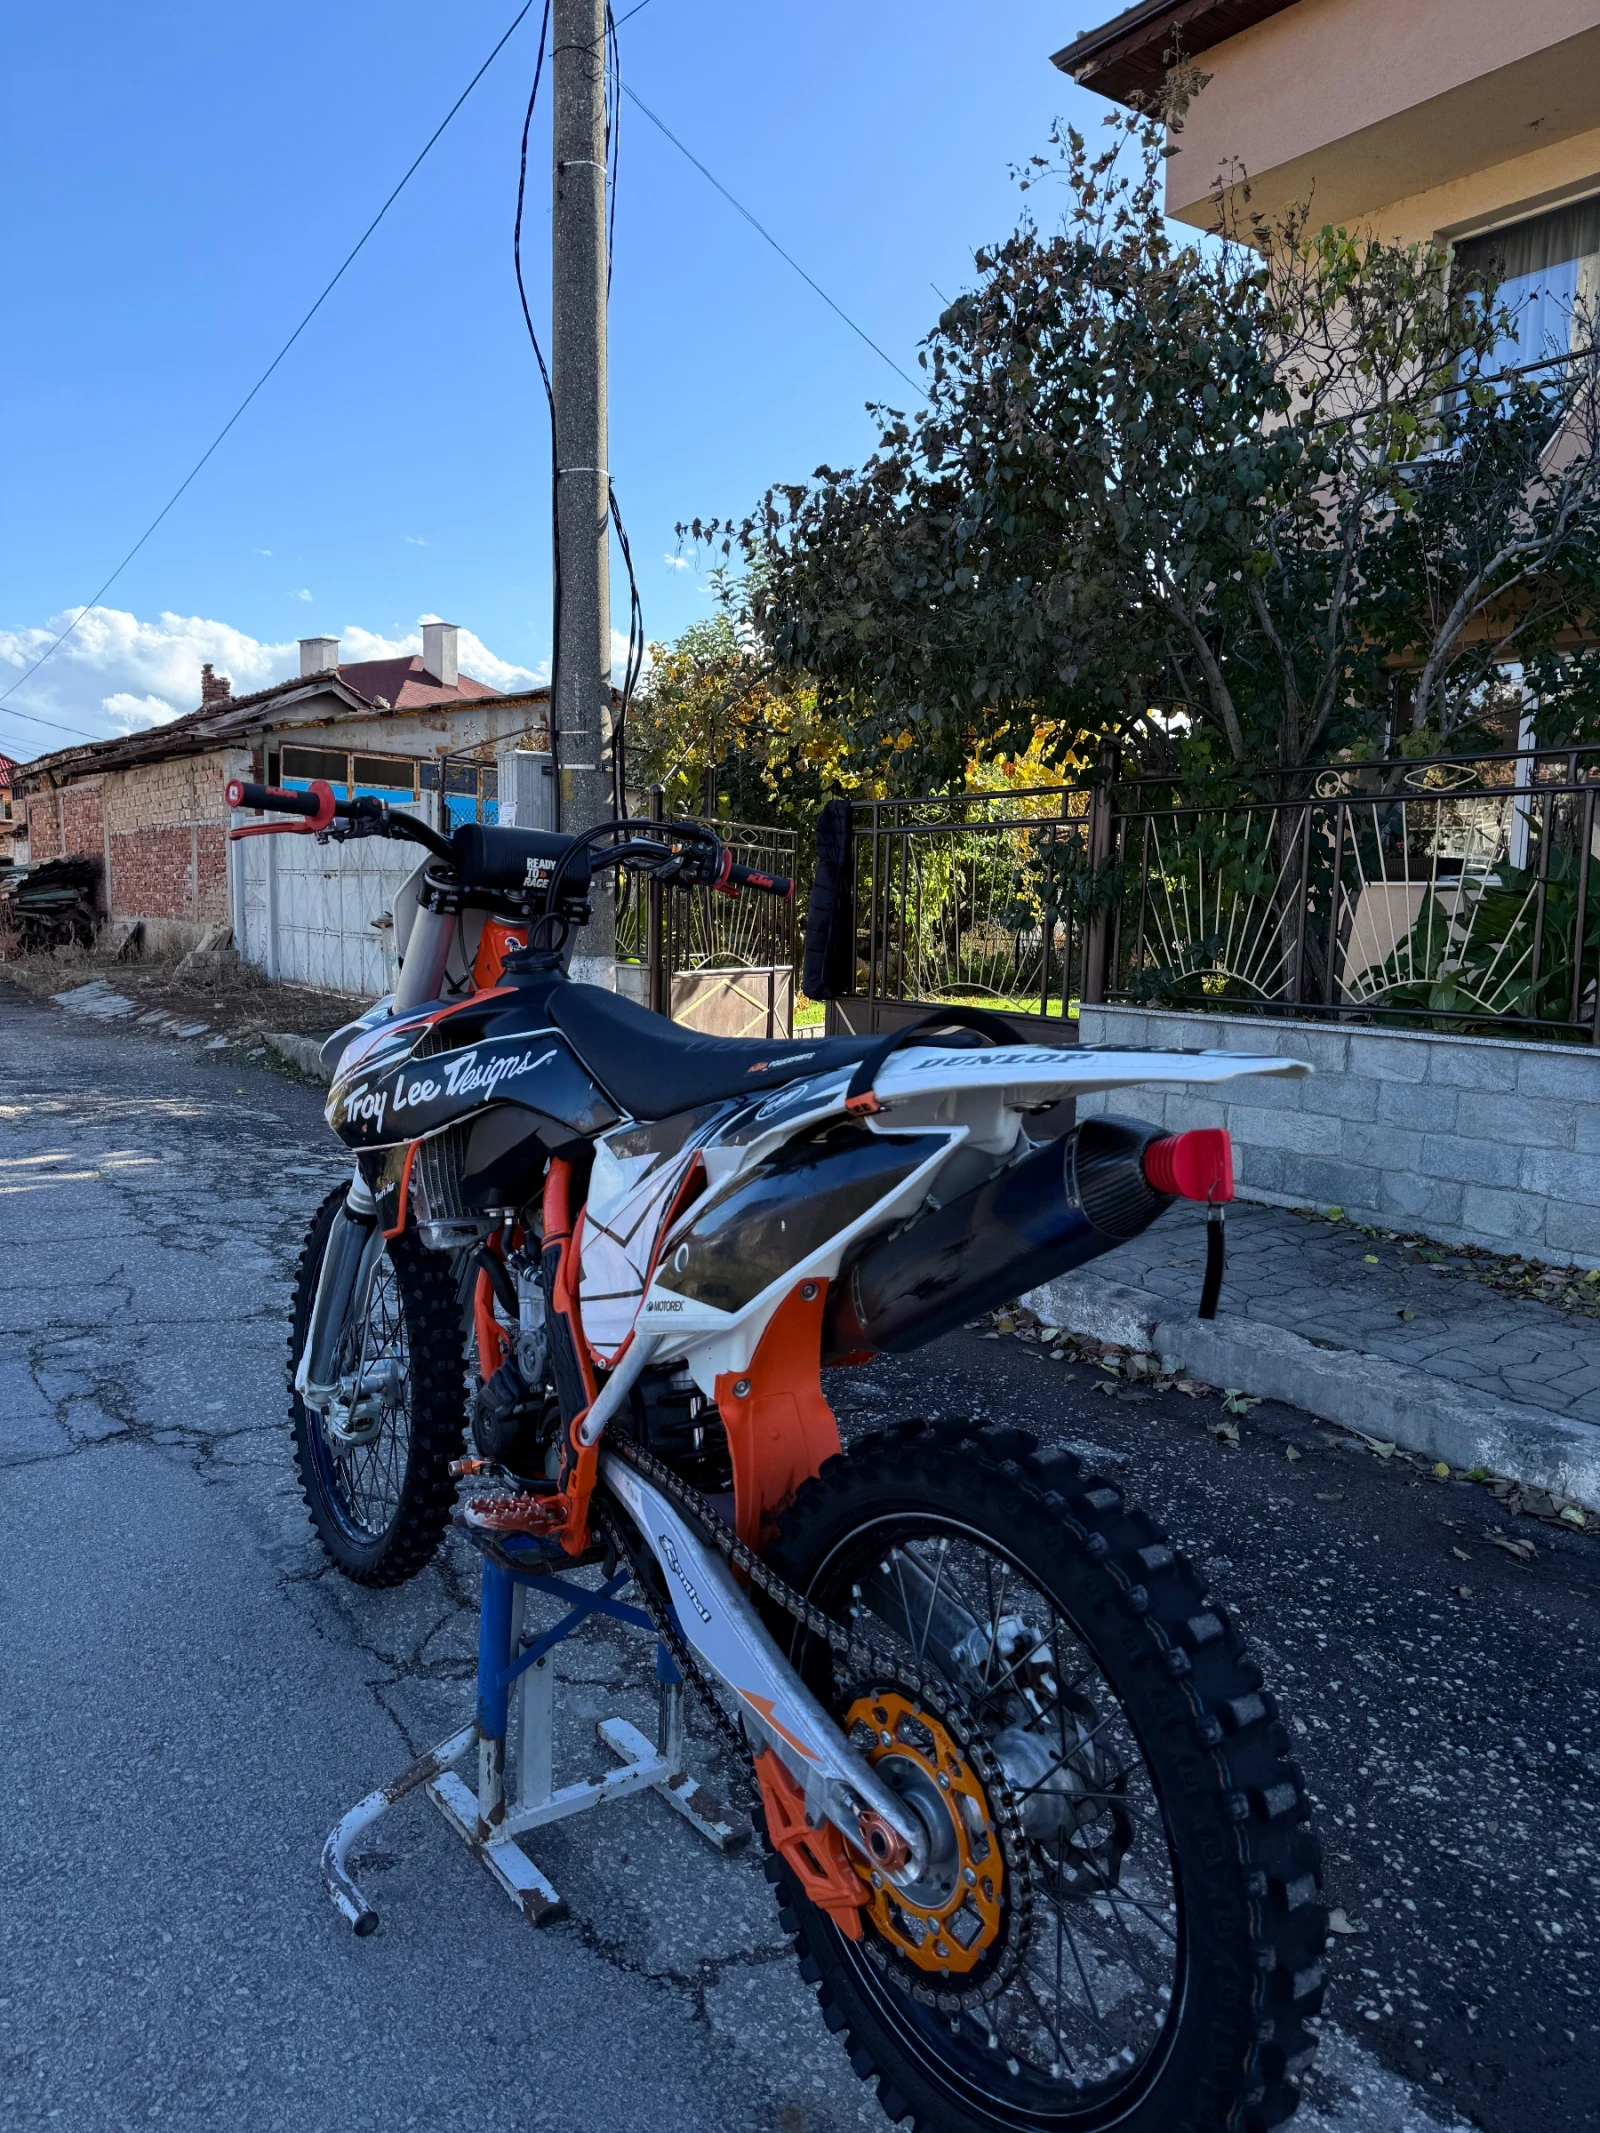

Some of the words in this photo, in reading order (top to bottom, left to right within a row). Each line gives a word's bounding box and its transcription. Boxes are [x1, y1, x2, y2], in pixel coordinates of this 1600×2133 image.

[527, 857, 557, 870] READY
[527, 868, 538, 878] TO
[523, 877, 550, 888] RACE
[746, 873, 774, 888] KTM
[909, 1053, 1094, 1071] DUNLOP
[344, 1082, 387, 1133] Troy
[392, 1074, 441, 1112] Lee
[444, 1050, 558, 1101] Designs
[654, 1300, 685, 1312] MOTOREX
[658, 1534, 713, 1624] Renthal
